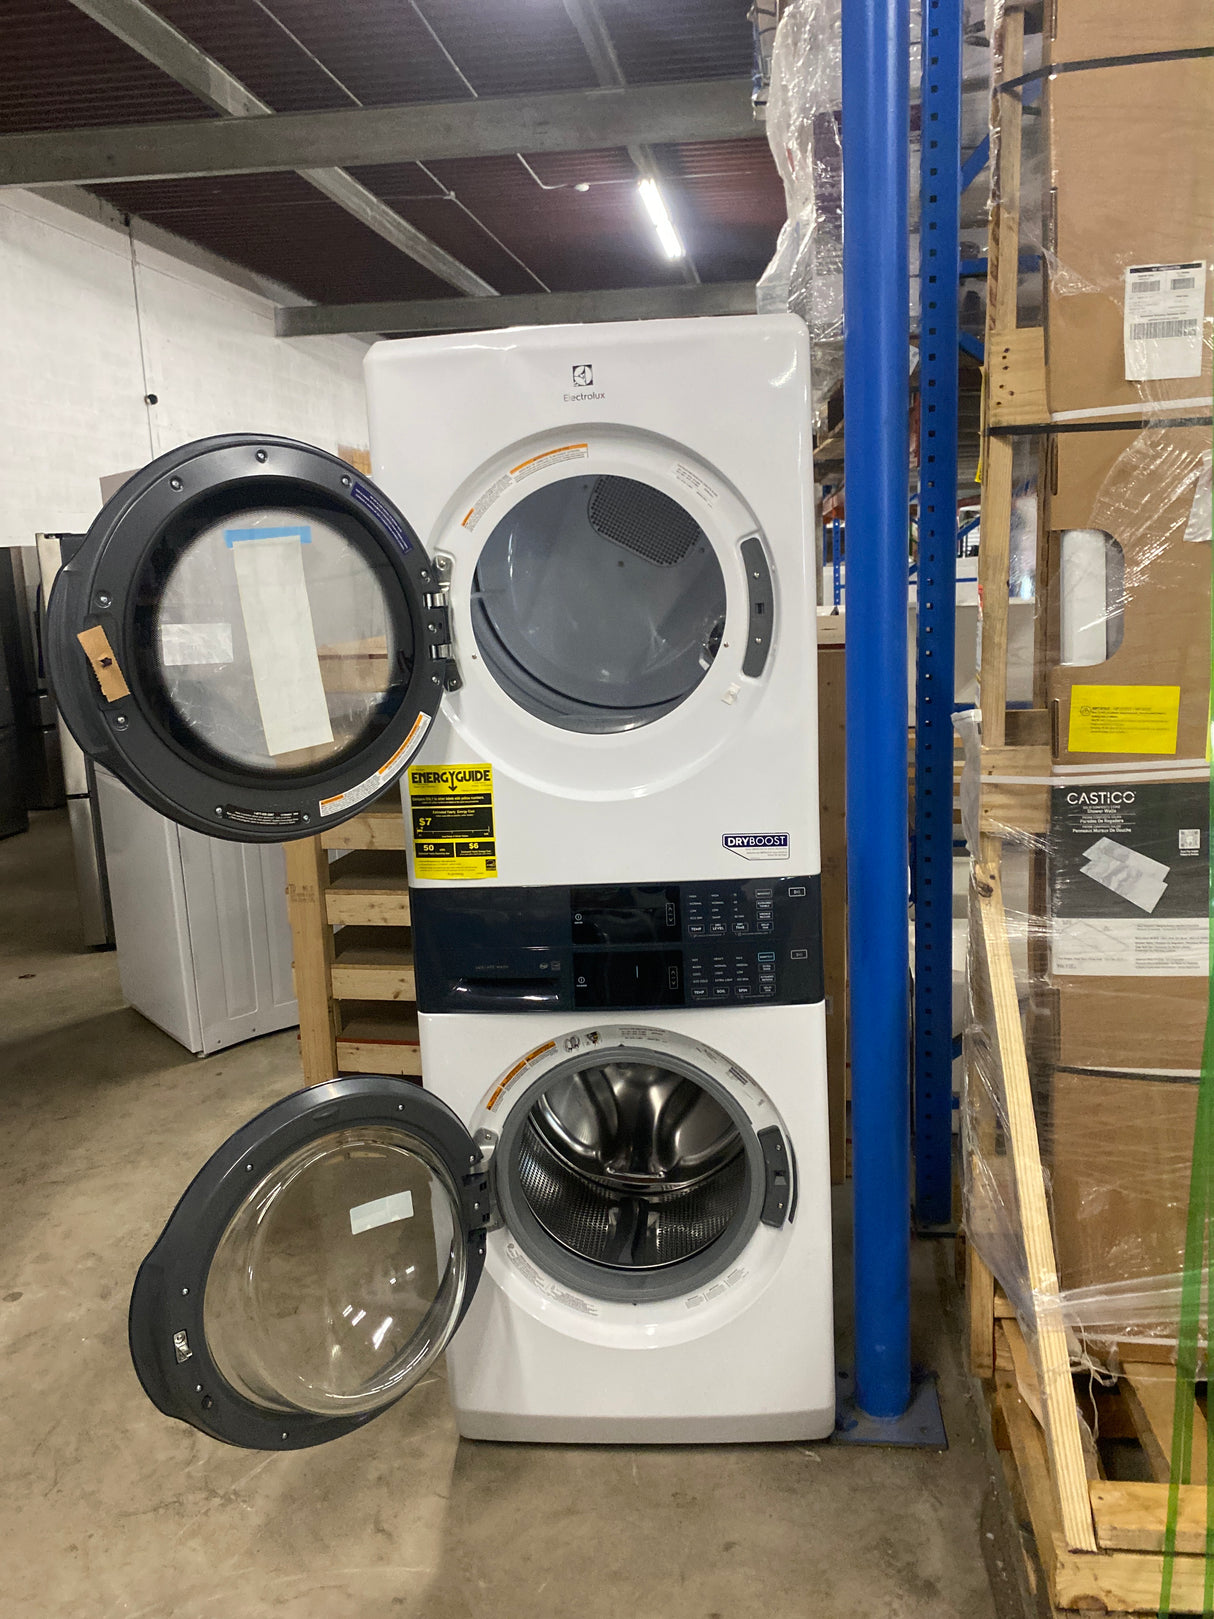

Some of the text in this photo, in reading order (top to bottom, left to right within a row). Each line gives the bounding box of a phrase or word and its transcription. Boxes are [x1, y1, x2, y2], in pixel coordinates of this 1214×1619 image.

[563, 392, 606, 402] Eectrolux
[411, 769, 491, 788] ENERGYGUIDE
[1066, 791, 1136, 805] CASTICO
[418, 817, 432, 826] $7
[468, 842, 479, 850] $6
[727, 836, 786, 846] DRYBOOST
